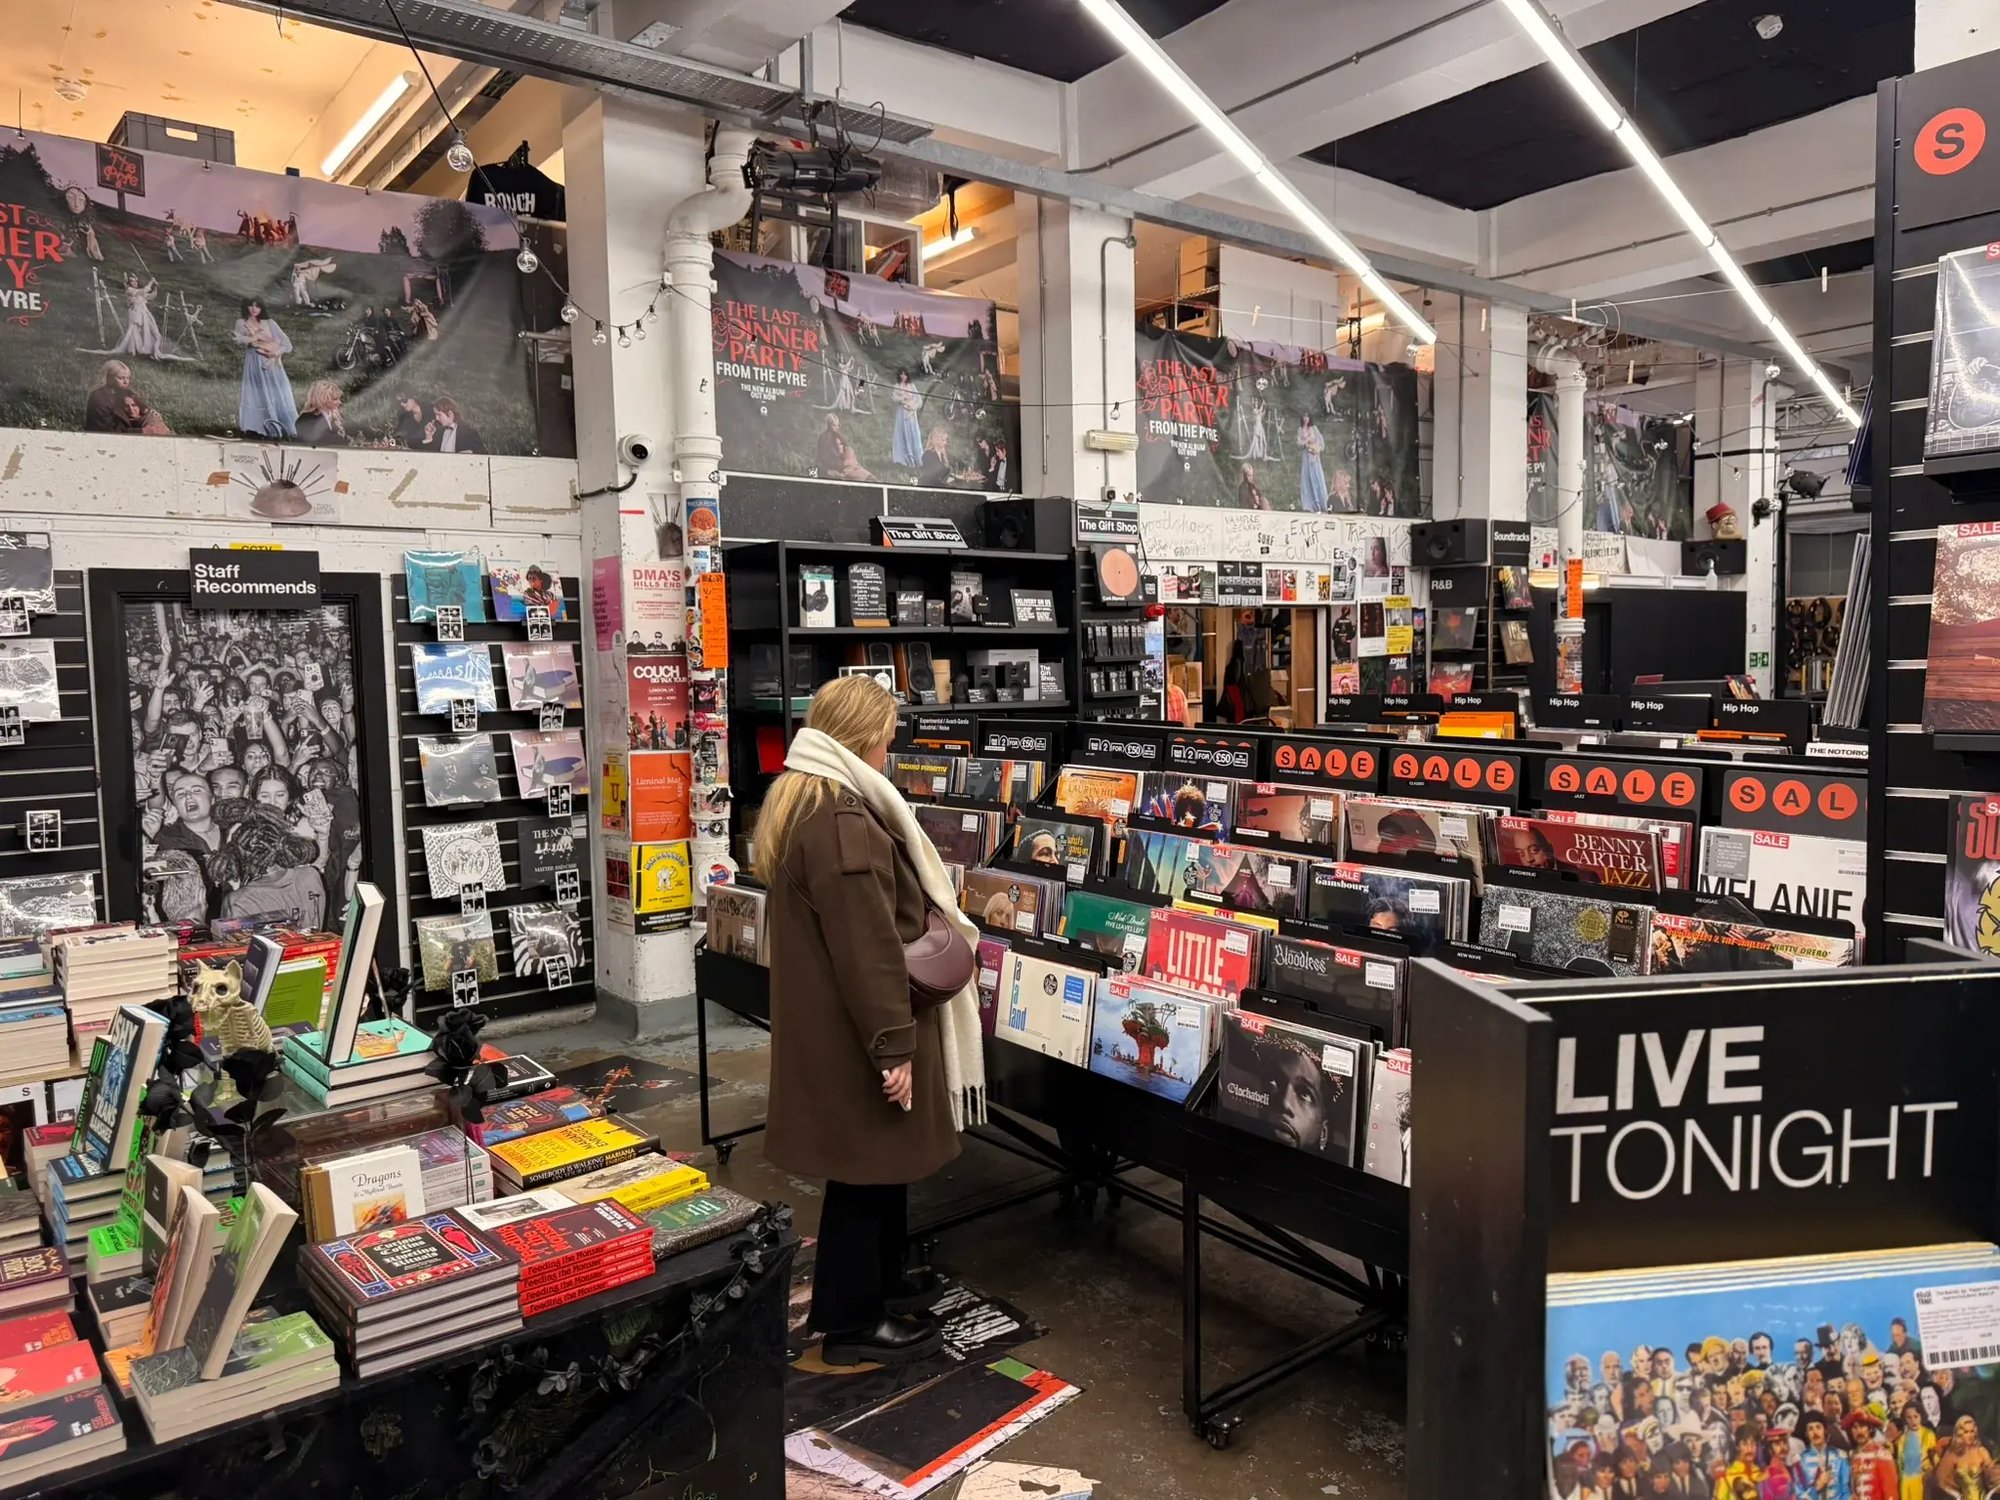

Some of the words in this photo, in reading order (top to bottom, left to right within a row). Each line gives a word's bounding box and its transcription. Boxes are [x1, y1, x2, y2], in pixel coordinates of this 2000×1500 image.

[726, 300, 757, 319] THE
[762, 302, 800, 326] LAST
[727, 318, 819, 353] DINNER
[730, 338, 803, 372] PARTY
[716, 361, 751, 380] FROM
[753, 365, 776, 384] THE
[777, 369, 807, 388] PYRE
[1157, 359, 1182, 377] THE
[1182, 363, 1217, 384] LAST
[763, 393, 777, 401] NOW
[1159, 374, 1230, 408] DINNER
[1160, 397, 1216, 427] PARTY
[1150, 420, 1177, 435] FROM
[1178, 422, 1198, 439] THE
[1080, 519, 1097, 531] The
[1099, 520, 1115, 532] Gift
[1116, 521, 1138, 535] Shop
[890, 530, 910, 540] The
[912, 531, 933, 541] Gift
[934, 532, 961, 543] Shop
[1493, 531, 1531, 542] Soundtracks
[194, 563, 241, 579] Staff
[633, 569, 681, 582] DMA'S
[194, 578, 317, 595] Recommends
[1431, 579, 1453, 590] R&B
[633, 665, 681, 679] COUCH
[1329, 697, 1338, 705] Hip
[1339, 697, 1352, 705] Hop
[1384, 697, 1394, 706] Hip
[1395, 697, 1409, 706] Hop
[1454, 696, 1466, 705] Hip
[1467, 696, 1482, 705] Hop
[1549, 697, 1561, 707] Hip
[1563, 697, 1580, 707] Hop
[1631, 700, 1645, 711] Hip
[1646, 700, 1664, 711] Hop
[1722, 703, 1738, 714] Hip
[1739, 703, 1759, 714] Hop
[919, 717, 943, 726] Experimental
[946, 718, 970, 726] Avant-Garde
[1000, 736, 1008, 747] 2
[1009, 738, 1019, 746] FOR
[1021, 738, 1034, 749] £50
[1102, 741, 1109, 752] 2
[1112, 743, 1123, 752] FOR
[1127, 744, 1141, 755] £50
[1187, 750, 1195, 760] 2
[1198, 751, 1210, 761] FOR
[1216, 753, 1231, 764] £50
[1809, 747, 1827, 755] THE
[1827, 748, 1868, 757] NOTORIO
[898, 762, 920, 772] TECHNO
[921, 763, 948, 774] PRIMITIV
[1281, 751, 1367, 773] SALE
[1400, 760, 1506, 785] SALE
[1068, 783, 1100, 795] LAURYN
[1256, 785, 1276, 794] SALE
[1558, 771, 1686, 799] SALE
[1501, 819, 1528, 830] SALE
[1573, 833, 1646, 856] BENNY
[1754, 833, 1788, 848] SALE
[1212, 848, 1231, 858] SALE
[1565, 849, 1649, 873] CARTER
[1334, 869, 1361, 882] SALE
[1600, 866, 1651, 887] JAZZ
[1315, 876, 1370, 894] Gainsbourg
[1695, 897, 1719, 905] REGGAE
[1151, 910, 1168, 922] SALE
[1216, 911, 1235, 920] SALE
[1654, 914, 1688, 930] SALE
[1166, 927, 1227, 986] LITTLE
[1273, 943, 1327, 974] Bloodless
[1334, 952, 1361, 967] SALE
[1457, 951, 1469, 959] NEW
[1469, 953, 1482, 961] WAVE
[1109, 984, 1130, 998] SALE
[1240, 1018, 1265, 1033] SALE
[113, 1013, 139, 1055] SHY
[1387, 1059, 1411, 1075] SALE
[1555, 1025, 1765, 1115] LIVE
[77, 1092, 90, 1128] EDITED
[86, 1073, 94, 1089] BY
[1550, 1101, 1959, 1203] TONIGHT
[529, 1166, 567, 1183] SOMEBODY
[566, 1164, 573, 1173] IS
[572, 1156, 605, 1171] WALKING
[604, 1147, 636, 1163] MARIANA
[351, 1169, 402, 1188] Dragons
[373, 1235, 423, 1252] Curious
[380, 1240, 426, 1257] Coffins
[23, 1252, 47, 1274] BOG
[383, 1246, 438, 1264] Riveting
[389, 1252, 439, 1268] Rituals
[527, 1258, 561, 1275] Feeding
[562, 1255, 575, 1266] the
[576, 1246, 605, 1260] Monster
[523, 1271, 558, 1289] Feeding
[559, 1268, 571, 1279] the
[572, 1259, 601, 1274] Monster
[525, 1283, 560, 1300] Feeding
[560, 1279, 573, 1290] the
[574, 1271, 603, 1286] Monster
[529, 1295, 563, 1313] Feeding
[564, 1292, 576, 1303] the
[577, 1283, 606, 1298] Monster
